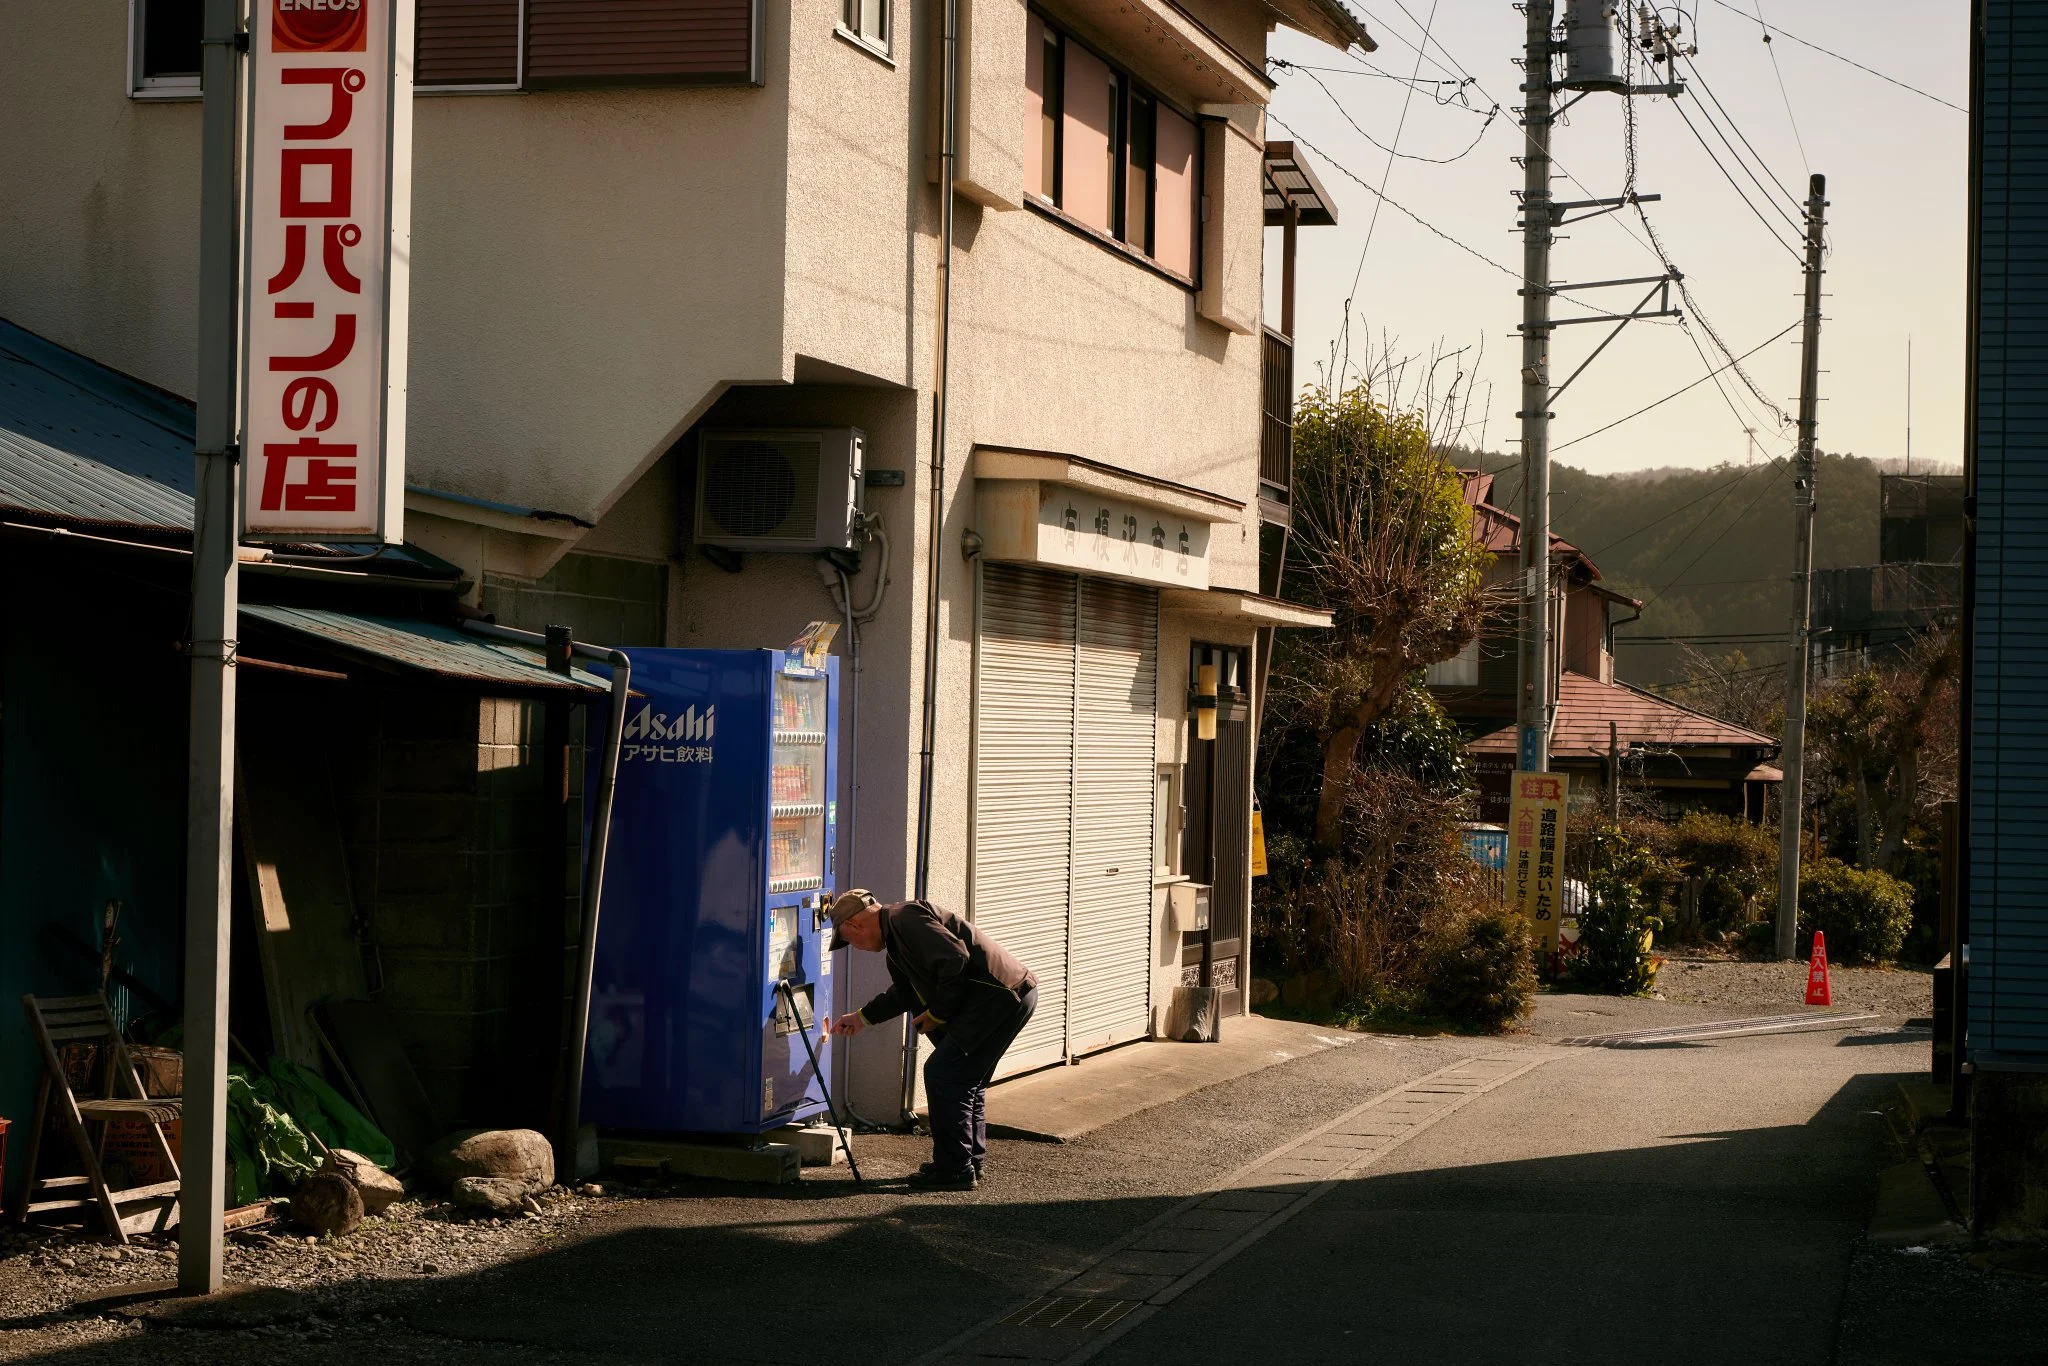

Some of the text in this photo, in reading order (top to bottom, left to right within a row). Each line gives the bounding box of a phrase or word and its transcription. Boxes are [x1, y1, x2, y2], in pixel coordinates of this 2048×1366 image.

[280, 0, 360, 11] ENEOS
[260, 67, 366, 512] プロパンの店
[624, 703, 716, 742] Asahi
[623, 744, 714, 764] アサヒ飲料
[1525, 781, 1556, 798] 注意
[1516, 806, 1534, 899] 大型車は通行でき
[1535, 808, 1558, 921] 道路幅員狭いため
[1812, 945, 1825, 997] 立入禁止
